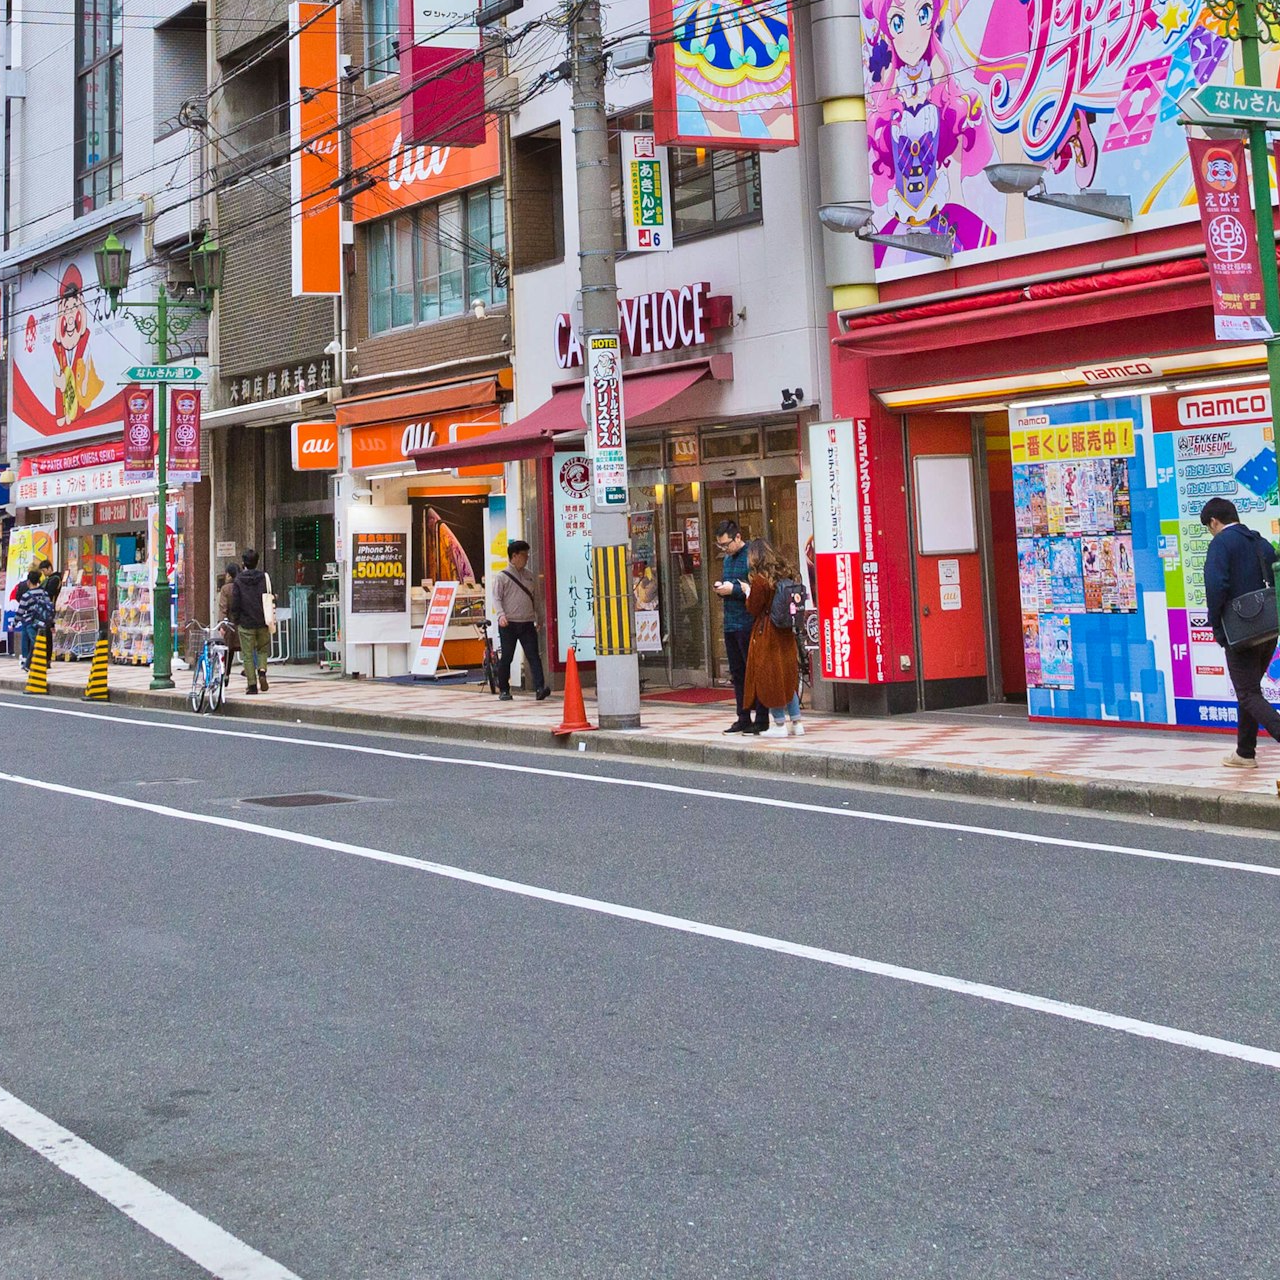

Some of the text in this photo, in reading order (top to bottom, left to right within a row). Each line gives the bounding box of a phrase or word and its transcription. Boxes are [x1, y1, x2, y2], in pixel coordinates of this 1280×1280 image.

[303, 138, 336, 155] au
[634, 136, 654, 158] 質
[639, 163, 655, 224] あきんど
[1205, 192, 1240, 208] えびす
[653, 232, 661, 246] 6
[621, 281, 706, 356] VELOCE
[592, 339, 618, 349] HOTEL
[135, 368, 194, 379] なんさん通り
[1082, 363, 1153, 381] namco
[597, 378, 611, 447] クリスマス
[1186, 394, 1265, 419] namco
[1018, 416, 1047, 426] namco
[302, 436, 334, 453] au
[401, 422, 437, 457] au
[1012, 428, 1131, 455] 一番くじ販売中!
[1189, 432, 1230, 443] TEKKEN
[1194, 442, 1236, 454] MUSEUM
[63, 455, 80, 469] ROLEX
[80, 451, 99, 466] OMEGA
[99, 449, 115, 463] SEIKO
[857, 419, 872, 505] ドラゴンスター
[1157, 466, 1174, 483] 3F
[358, 545, 384, 555] iPhone
[944, 592, 959, 601] au
[836, 554, 850, 677] ドラゴンスター
[1172, 643, 1187, 660] 1F
[1198, 705, 1238, 724] 営業時間
